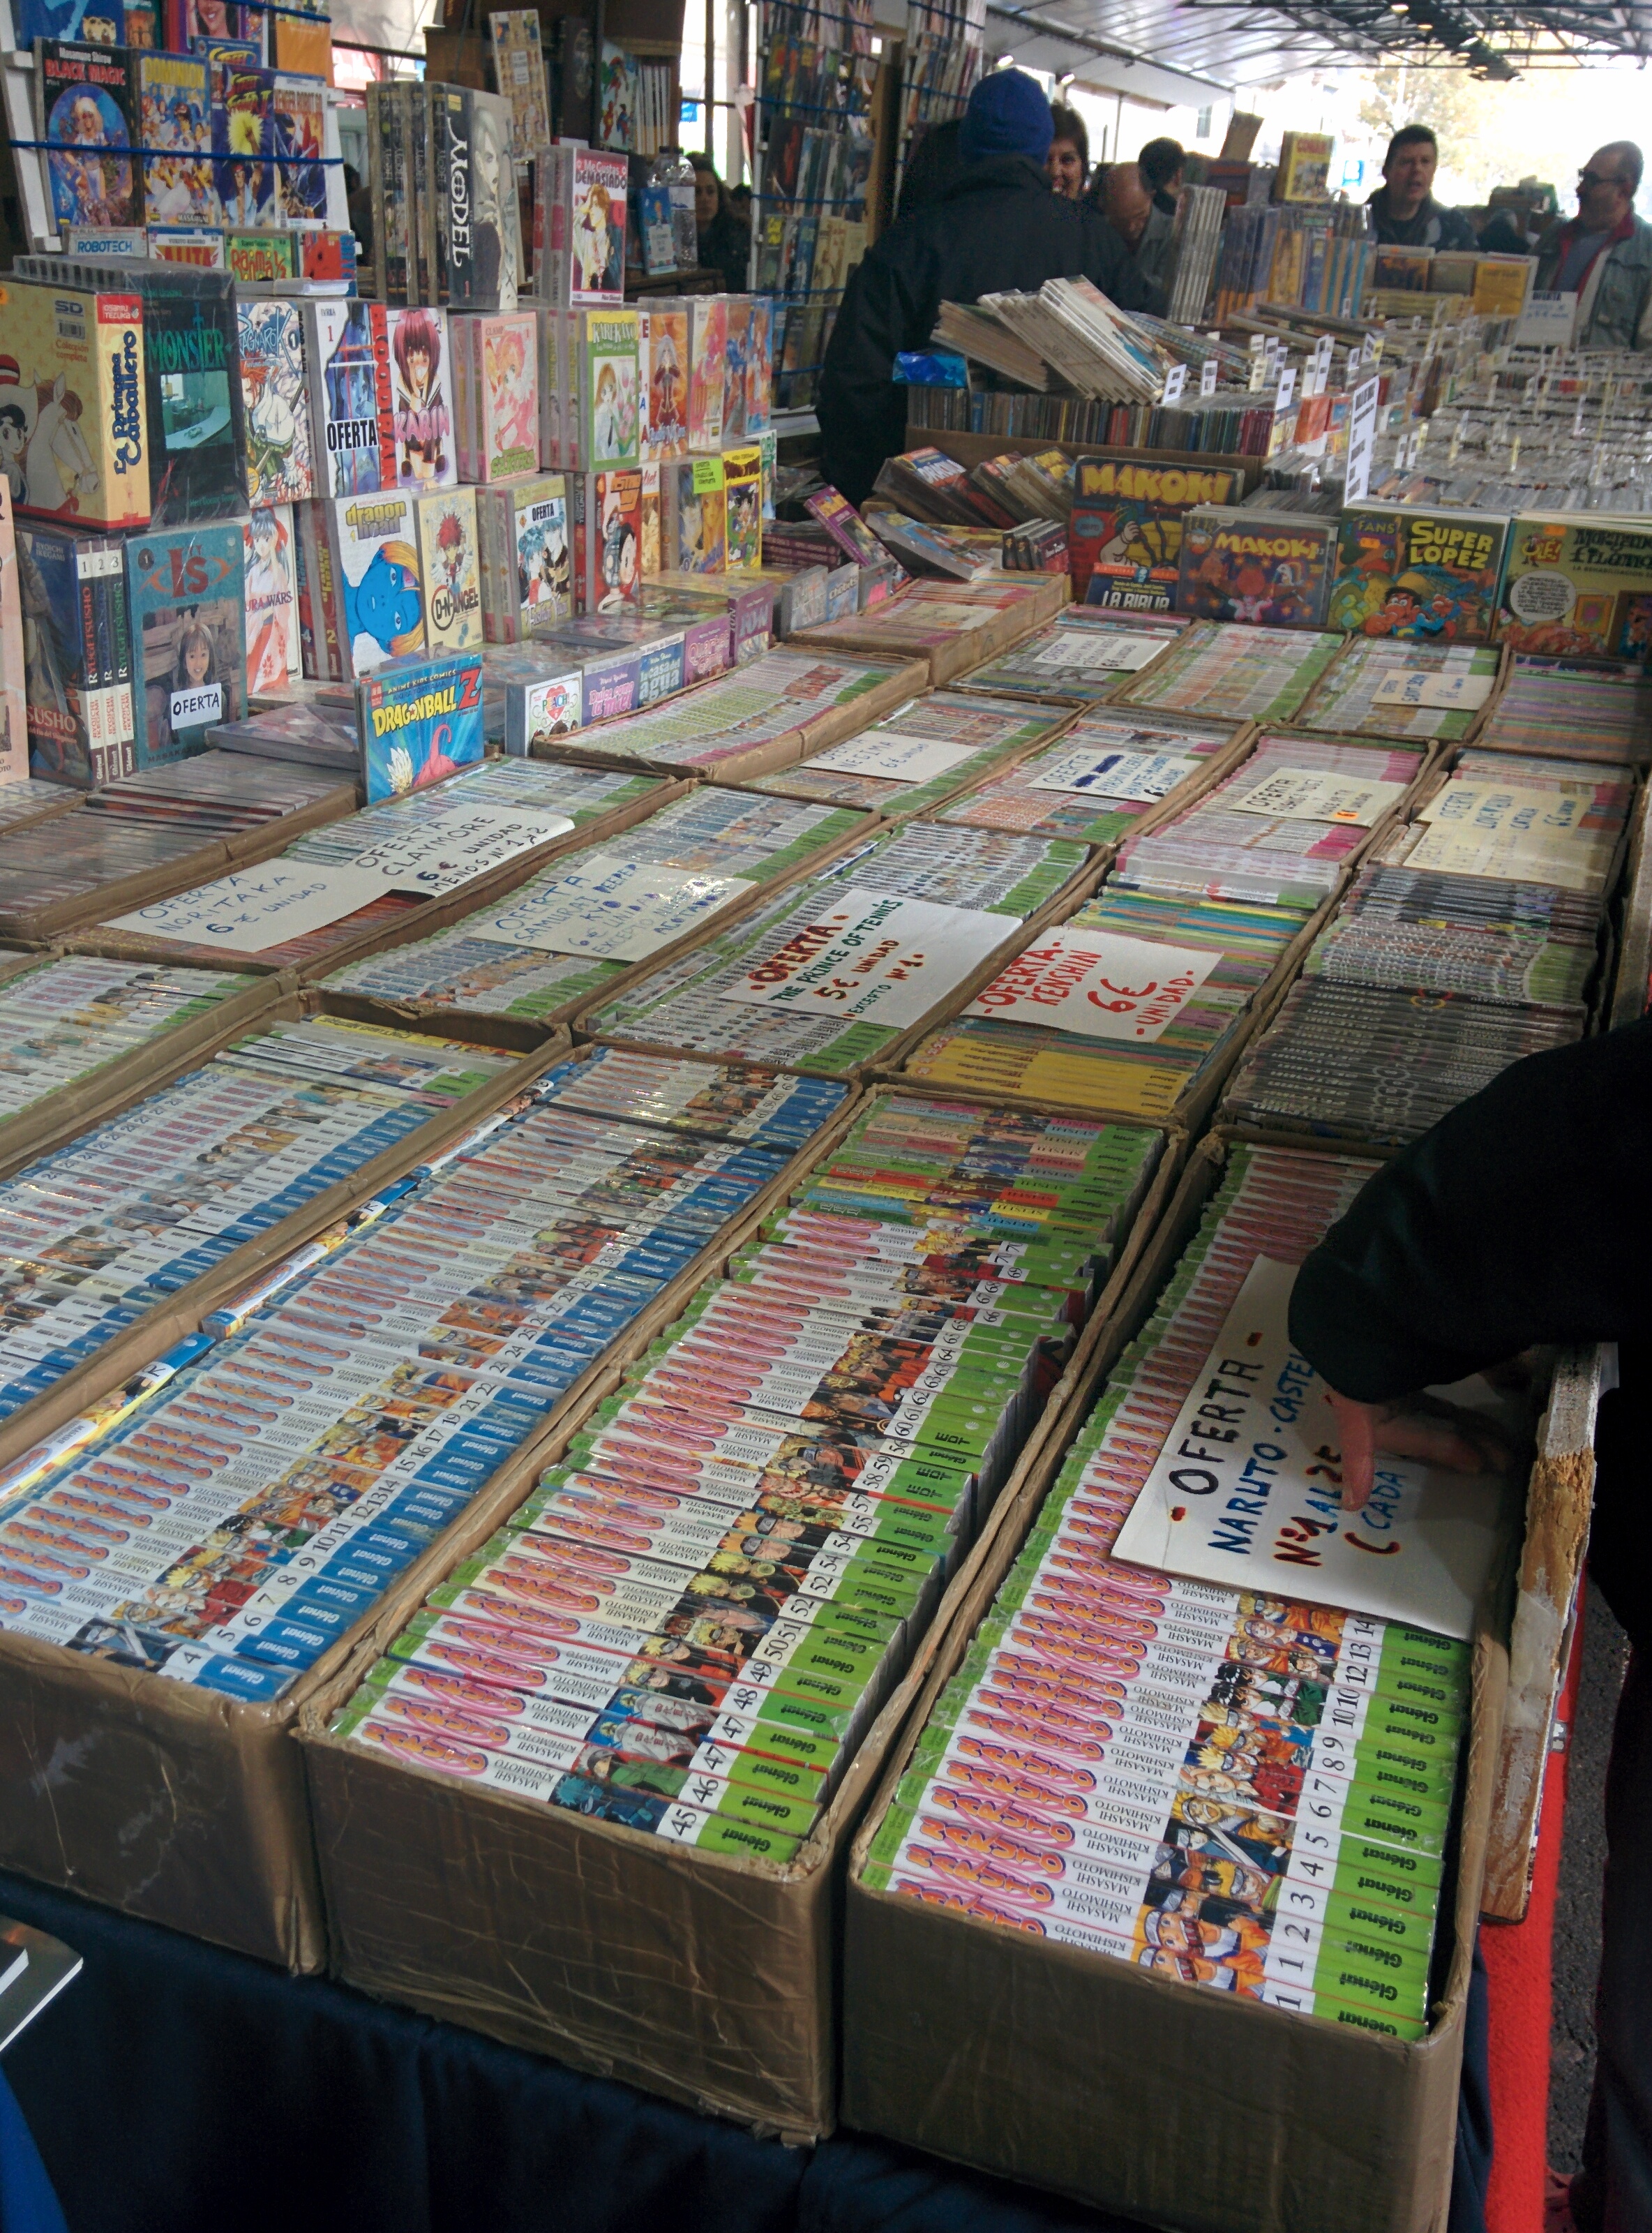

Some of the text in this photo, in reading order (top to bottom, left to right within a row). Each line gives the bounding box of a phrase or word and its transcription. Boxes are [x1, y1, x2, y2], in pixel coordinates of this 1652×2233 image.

[45, 59, 126, 85] BLACK MAGIC
[144, 55, 206, 90] DOMINION
[575, 171, 626, 189] DEMASIADO
[583, 160, 619, 174] Me Gustas
[447, 117, 472, 268] MODEL
[77, 240, 133, 253] ROBOTECH
[464, 281, 470, 297] 1
[55, 300, 83, 314] SD
[288, 334, 297, 348] 1
[328, 325, 333, 341] 1
[147, 329, 227, 374] MONSTER
[124, 330, 142, 466] Caballero
[112, 353, 128, 475] La Princesa
[393, 406, 449, 443] KARIN
[327, 420, 377, 451] OFERTA
[491, 450, 536, 480] SAKURA
[1081, 463, 1233, 505] MAKOKI
[346, 501, 406, 526] dragon
[532, 503, 555, 521] OFERTA
[350, 532, 356, 542] 1
[357, 519, 401, 539] head
[1358, 521, 1395, 535] FANS
[1411, 521, 1494, 553] SUPER
[36, 542, 63, 553] RYOICHI
[36, 548, 65, 560] IKEGAMI
[1215, 532, 1320, 558] MAKOKI
[1410, 546, 1489, 569] LOPEZ
[82, 562, 88, 572] 1
[98, 559, 105, 569] 2
[112, 557, 119, 567] 3
[266, 591, 292, 606] WARS
[327, 629, 336, 643] 2
[389, 669, 456, 694] ANIME KIDS COMICS
[647, 664, 668, 680] casa
[459, 666, 483, 710] Z
[589, 682, 635, 705] Dulce como
[640, 671, 679, 704] agua
[173, 692, 219, 715] OFERTA
[542, 693, 570, 711] PEACH!
[591, 691, 633, 719] la miel
[837, 741, 897, 768] NEGIMA
[1042, 754, 1097, 784] OFERTA
[1246, 779, 1298, 807] OFERTA
[1439, 791, 1482, 819] OFERTA
[355, 820, 450, 869] OFERTA
[383, 816, 495, 876] CLAYMORE
[466, 823, 523, 855] UNIDAD
[432, 860, 488, 892] MENOS
[140, 875, 244, 920] OFERTA
[156, 876, 296, 934] NORITAKA
[263, 883, 327, 912] UNIDAD
[496, 876, 591, 930] OFERTA
[515, 864, 640, 941] SAMURAI DEEPER
[580, 900, 621, 920] KYO
[592, 918, 654, 954] EXCEPTO
[749, 925, 843, 983] OFERTA
[768, 899, 903, 1001] THE PRINCE OF TENNIS
[813, 939, 900, 1000] 5€ UNIDAD
[976, 949, 1064, 1006] OFERTA
[1025, 950, 1102, 1006] KENSHIN
[847, 985, 892, 1015] EXCEPTO
[1087, 978, 1157, 1013] 6€
[1135, 978, 1194, 1026] UNIDAD
[1169, 1358, 1265, 1495] OFERTA
[1208, 1442, 1288, 1554] NARUTO
[1306, 1485, 1344, 1515] AL
[1361, 1470, 1409, 1530] CADA
[183, 1650, 203, 1665] 4
[220, 1663, 265, 1685] Glénat
[750, 1659, 772, 1685] 49
[734, 1689, 758, 1712] 48
[384, 1696, 564, 1761] NARUTO MASASHI
[518, 1731, 577, 1754] KISHIMOTO
[361, 1722, 541, 1791] NARUTO MASASHI
[705, 1745, 730, 1770] 47
[1324, 1756, 1346, 1772] 8
[494, 1758, 555, 1784] KISHIMOTO
[693, 1779, 719, 1804] 46
[1314, 1779, 1336, 1794] 7
[742, 1795, 790, 1819] Glénat
[1310, 1802, 1333, 1819] 6
[670, 1809, 698, 1837] 45
[932, 1786, 1139, 1862] NARUTO MASASHI
[721, 1828, 771, 1853] Glénat
[1083, 1828, 1150, 1854] KISHIMOTO
[1305, 1832, 1329, 1849] 5
[920, 1816, 1129, 1896] NARUTO MASASHI
[1300, 1860, 1324, 1879] 4
[1362, 1846, 1417, 1872] Glénat
[908, 1844, 1120, 1924] NARUTO MASASHI
[1072, 1859, 1141, 1887] KISHIMOTO
[1062, 1888, 1132, 1915] KISHIMOTO
[1291, 1892, 1316, 1911] 3
[1358, 1876, 1412, 1902] Glénat
[1284, 1923, 1311, 1943] 2
[1350, 1907, 1405, 1936] Glénat
[1279, 1955, 1305, 1973] 1
[1346, 1939, 1402, 1969] Glénat
[1340, 1971, 1398, 2002] Glénat
